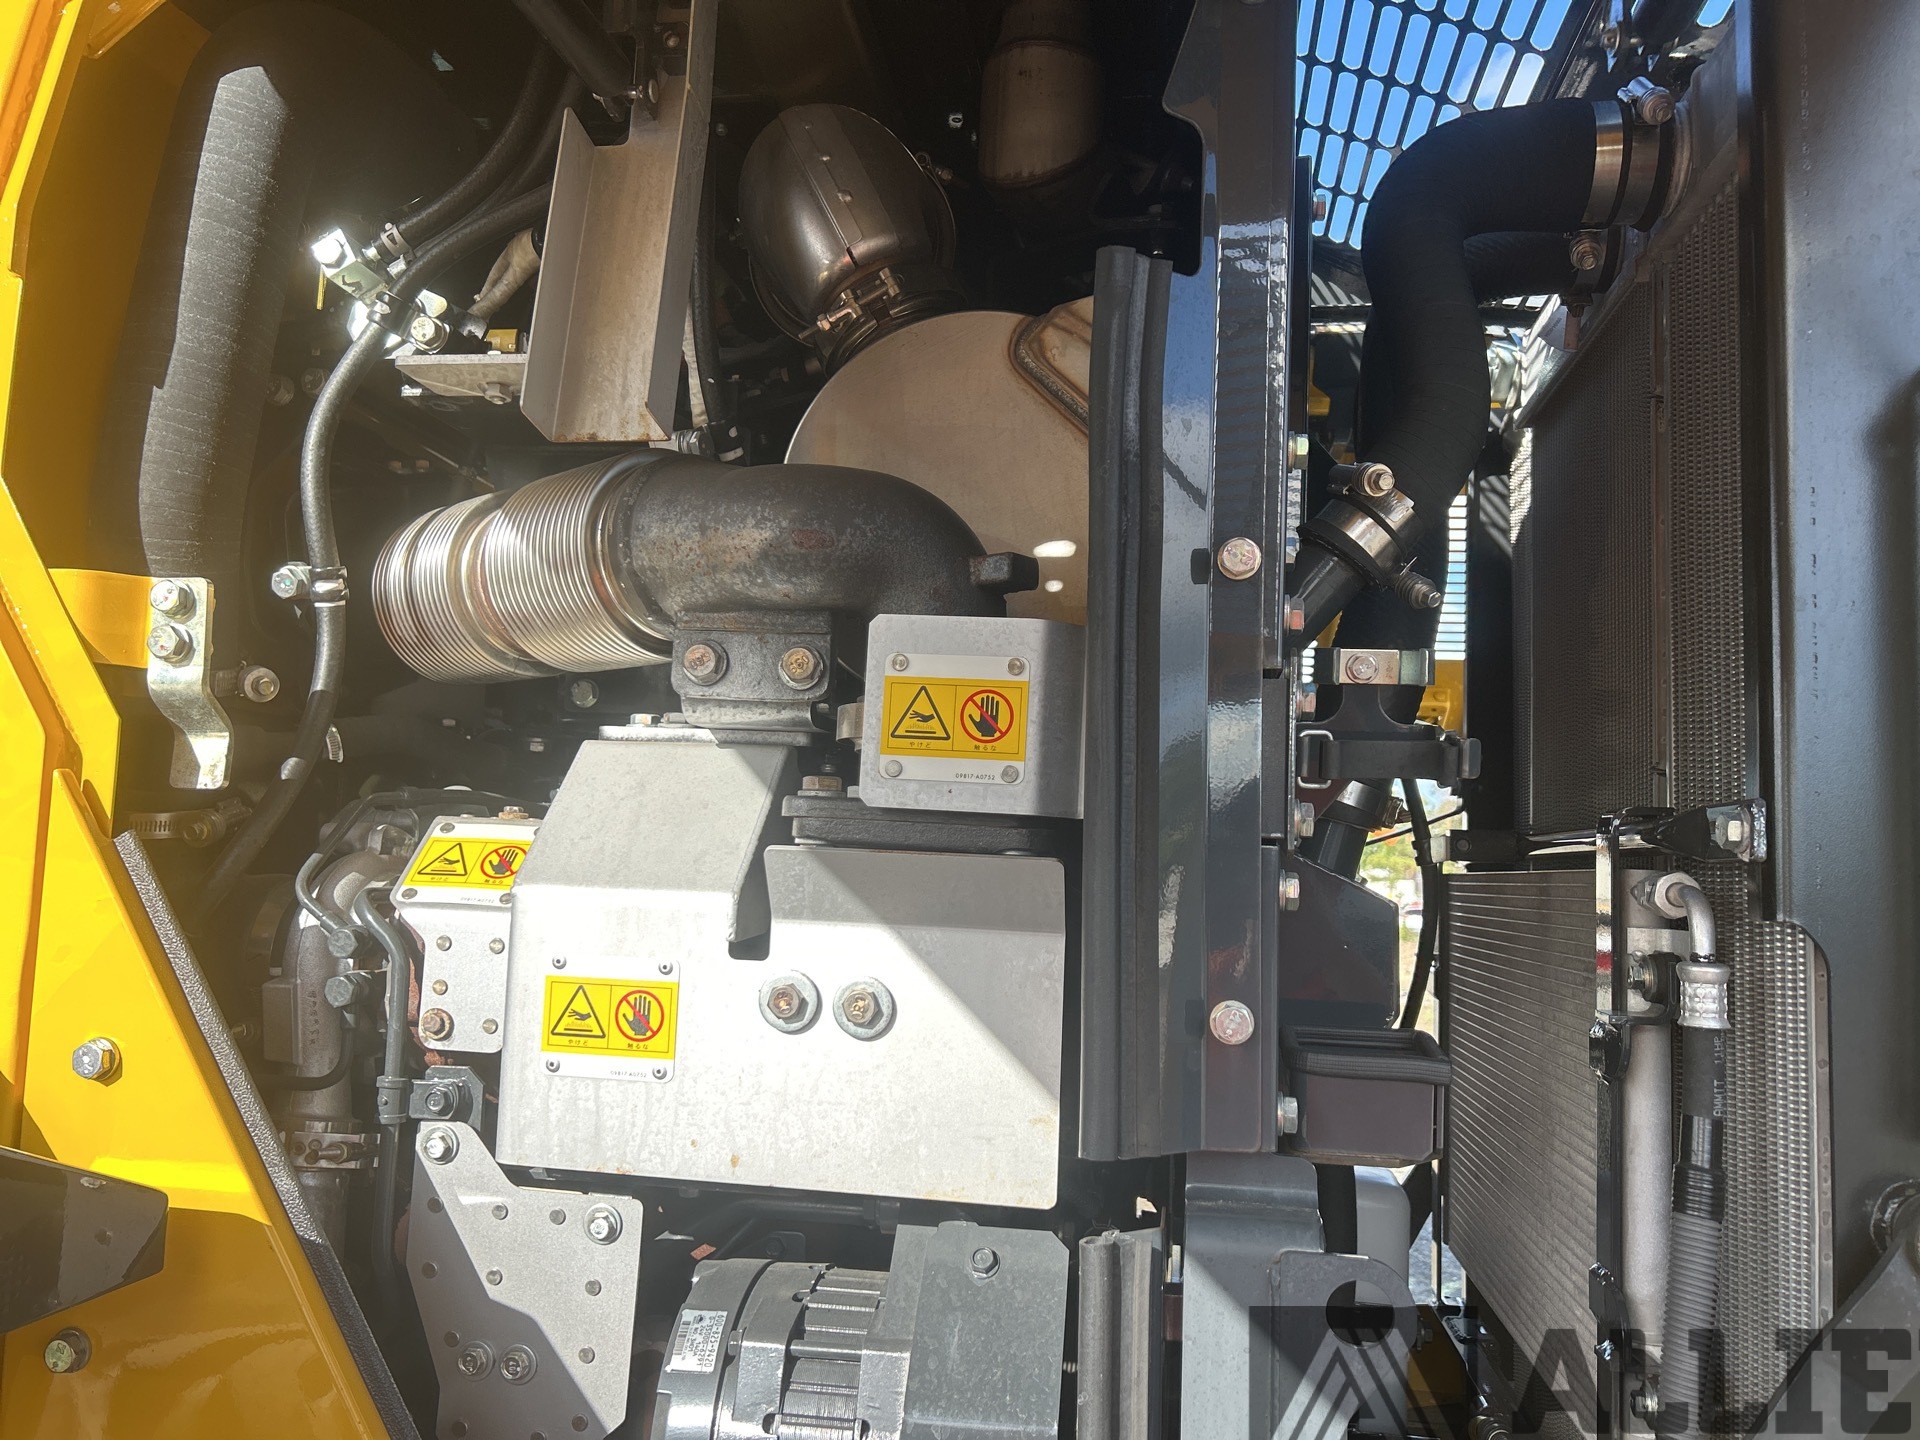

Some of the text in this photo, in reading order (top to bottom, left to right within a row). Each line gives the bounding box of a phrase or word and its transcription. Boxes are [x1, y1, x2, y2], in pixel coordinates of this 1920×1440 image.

[973, 744, 997, 752] 触るな
[955, 772, 996, 781] 09817-A0752
[703, 1314, 725, 1368] 600-825-9420
